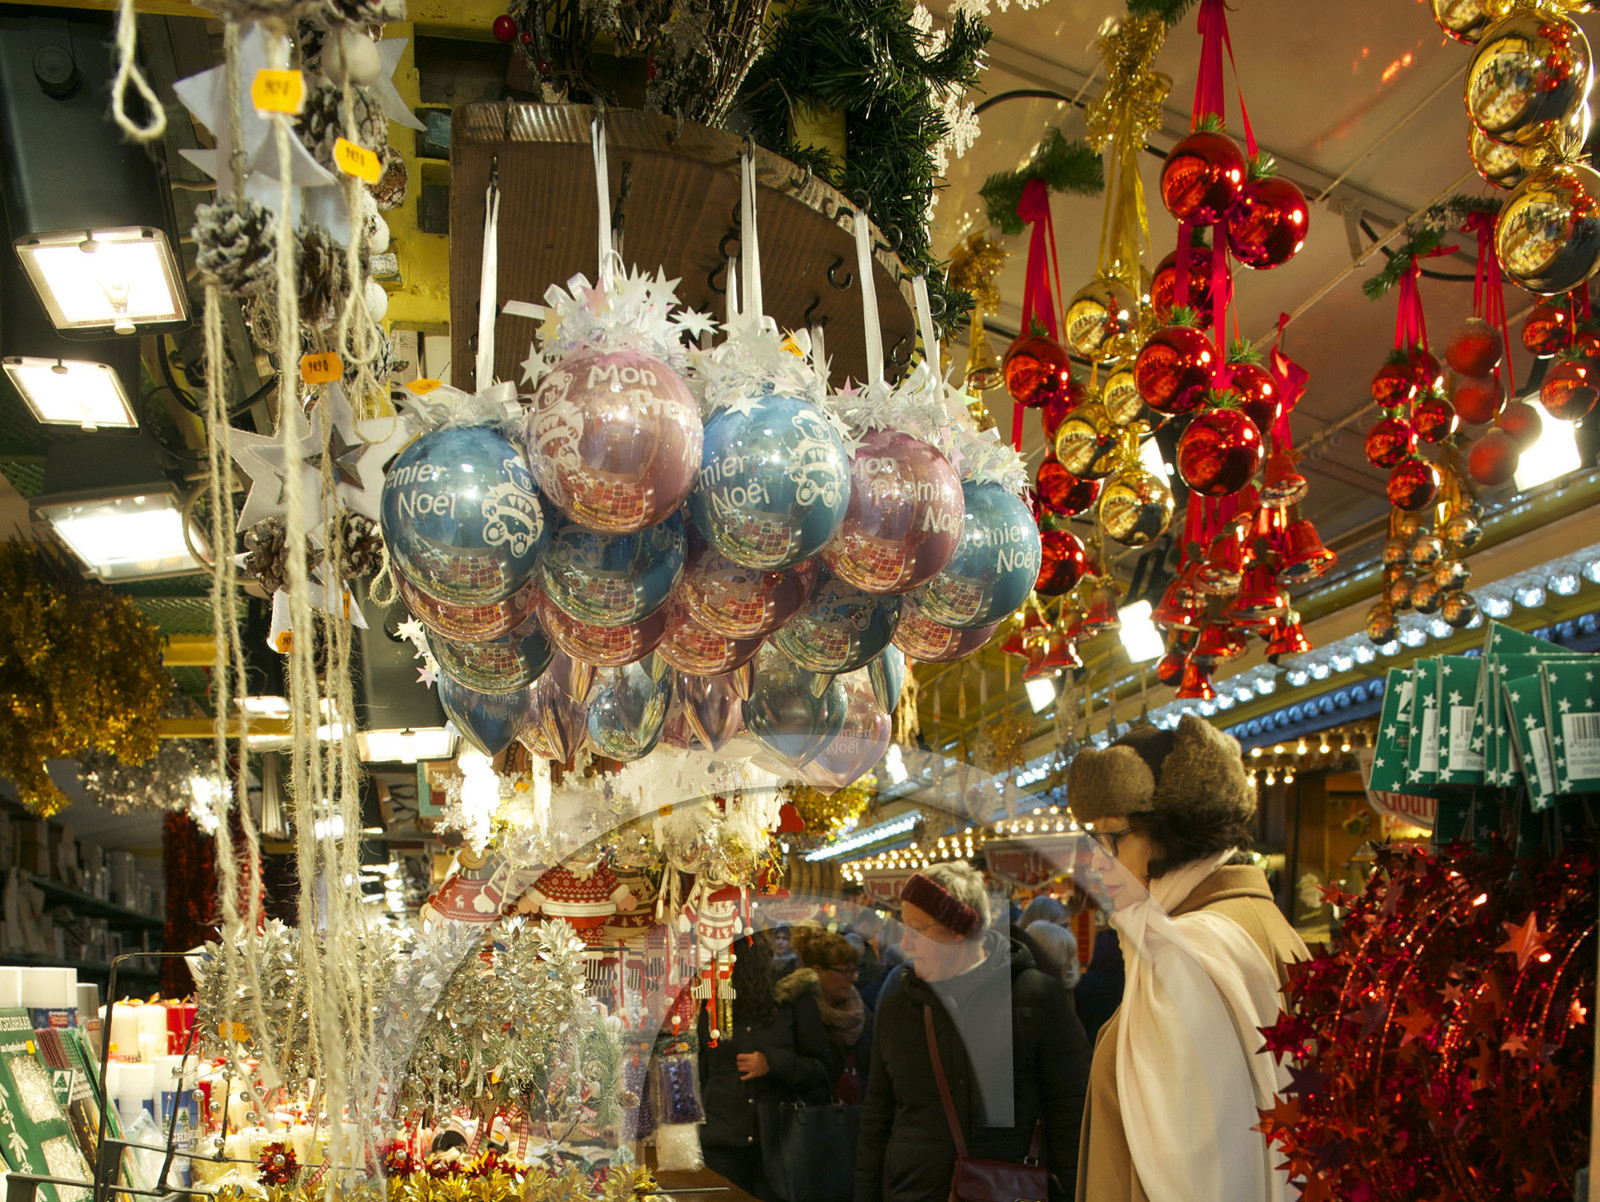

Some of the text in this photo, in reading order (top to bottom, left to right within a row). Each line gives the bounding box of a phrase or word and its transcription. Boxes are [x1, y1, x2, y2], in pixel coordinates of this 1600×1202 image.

[587, 363, 657, 392] Mon
[398, 489, 457, 520] Noël
[711, 476, 771, 517] Noël
[826, 739, 860, 756] Noël
